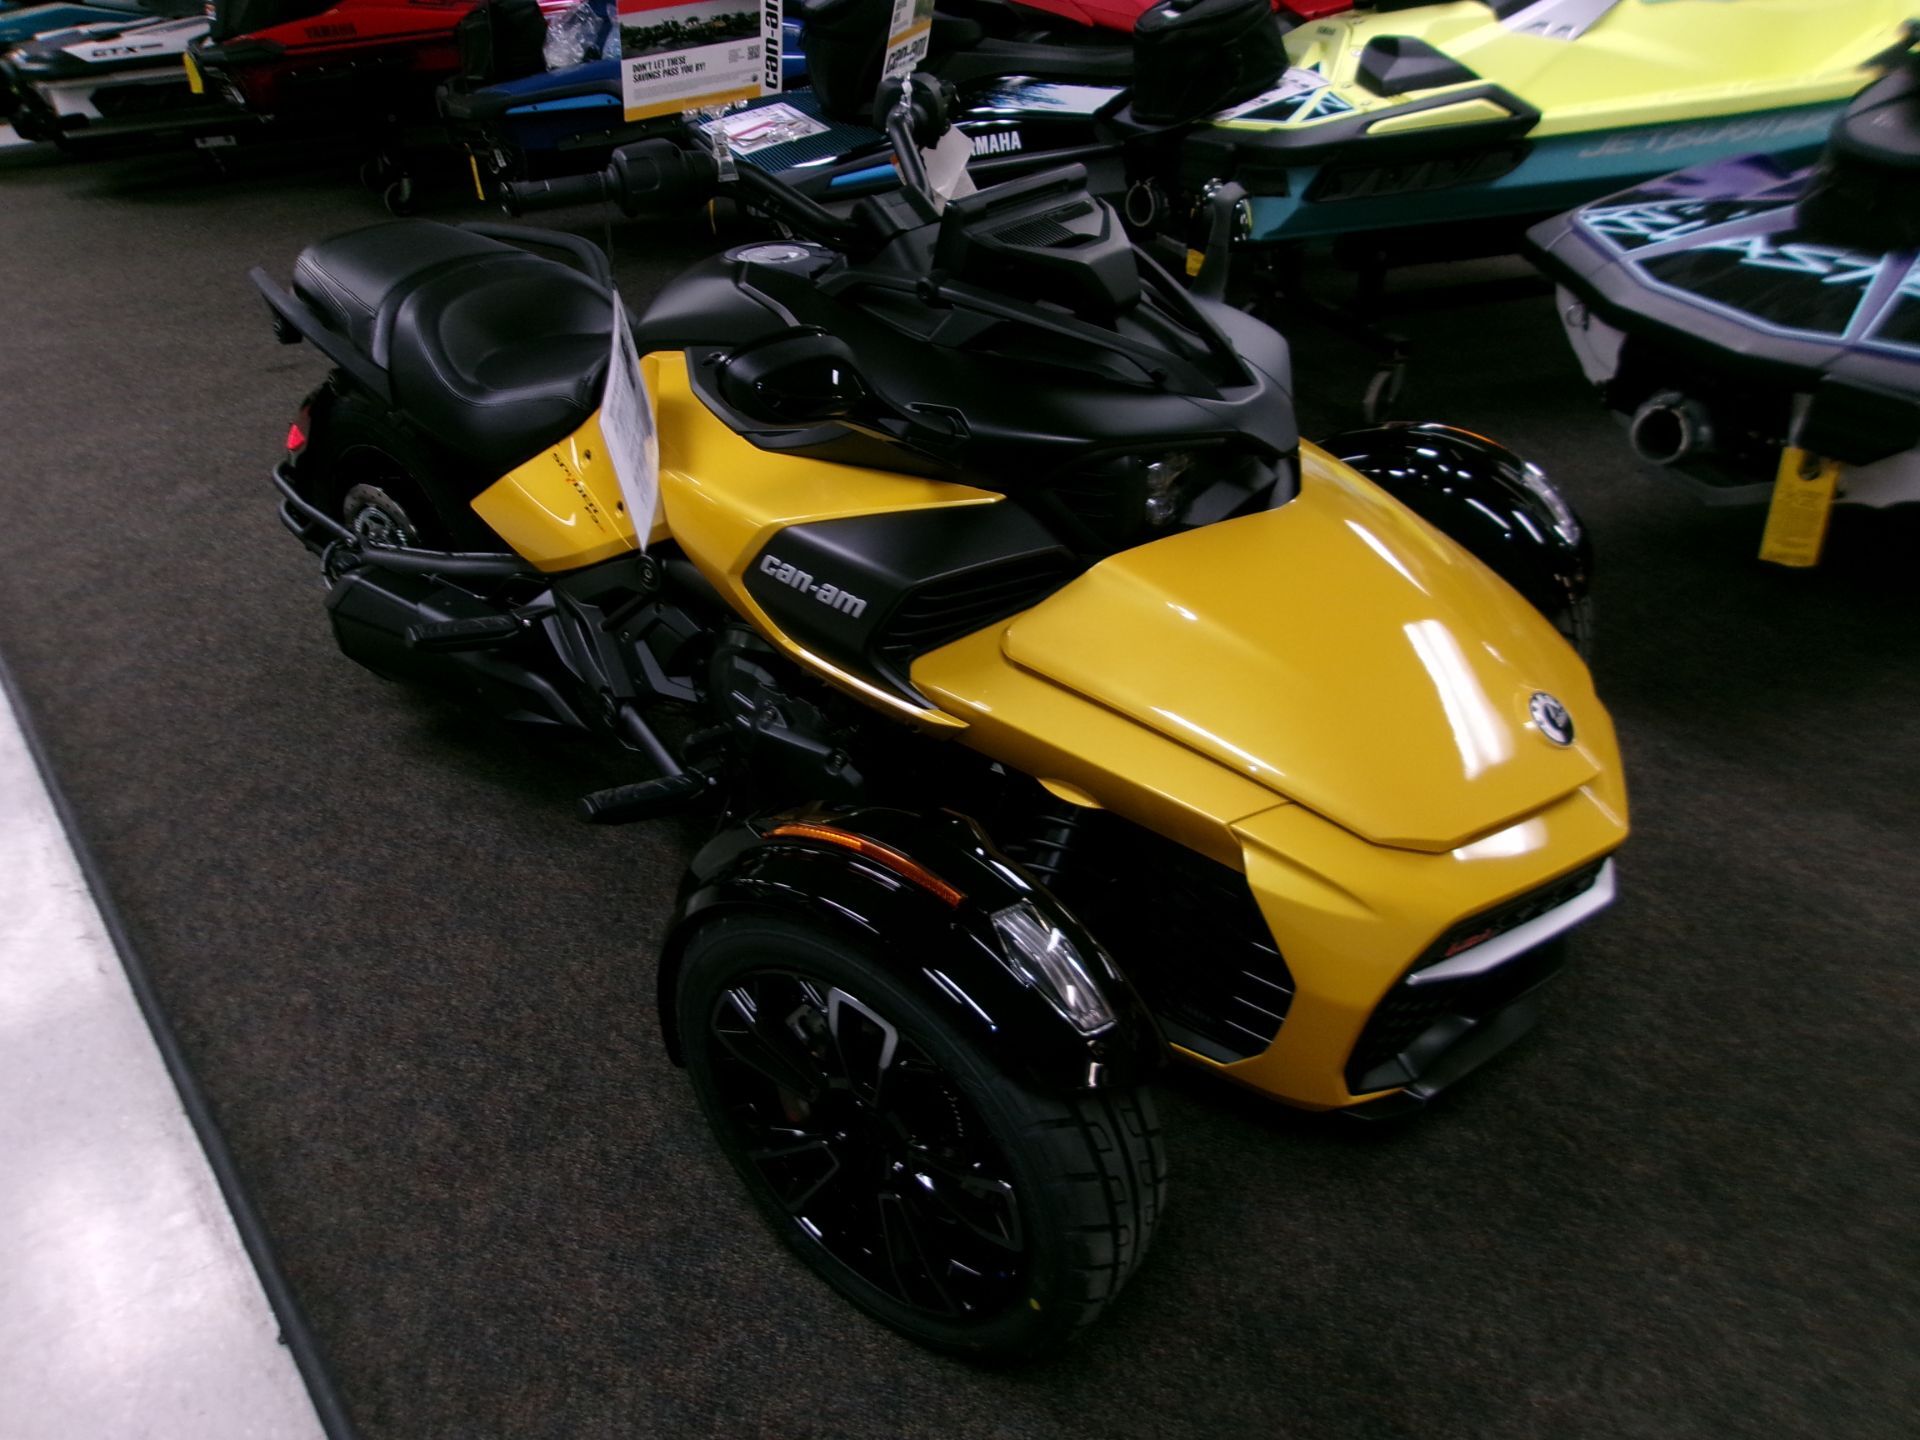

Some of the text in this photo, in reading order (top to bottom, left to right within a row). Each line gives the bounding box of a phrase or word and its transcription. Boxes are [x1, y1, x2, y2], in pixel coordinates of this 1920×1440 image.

[632, 56, 686, 73] DON'T LET THESE
[633, 70, 662, 83] SAVINGS
[662, 67, 679, 78] PASS
[681, 64, 694, 74] YOU
[970, 130, 1022, 156] MAHA
[760, 554, 867, 618] can-am
